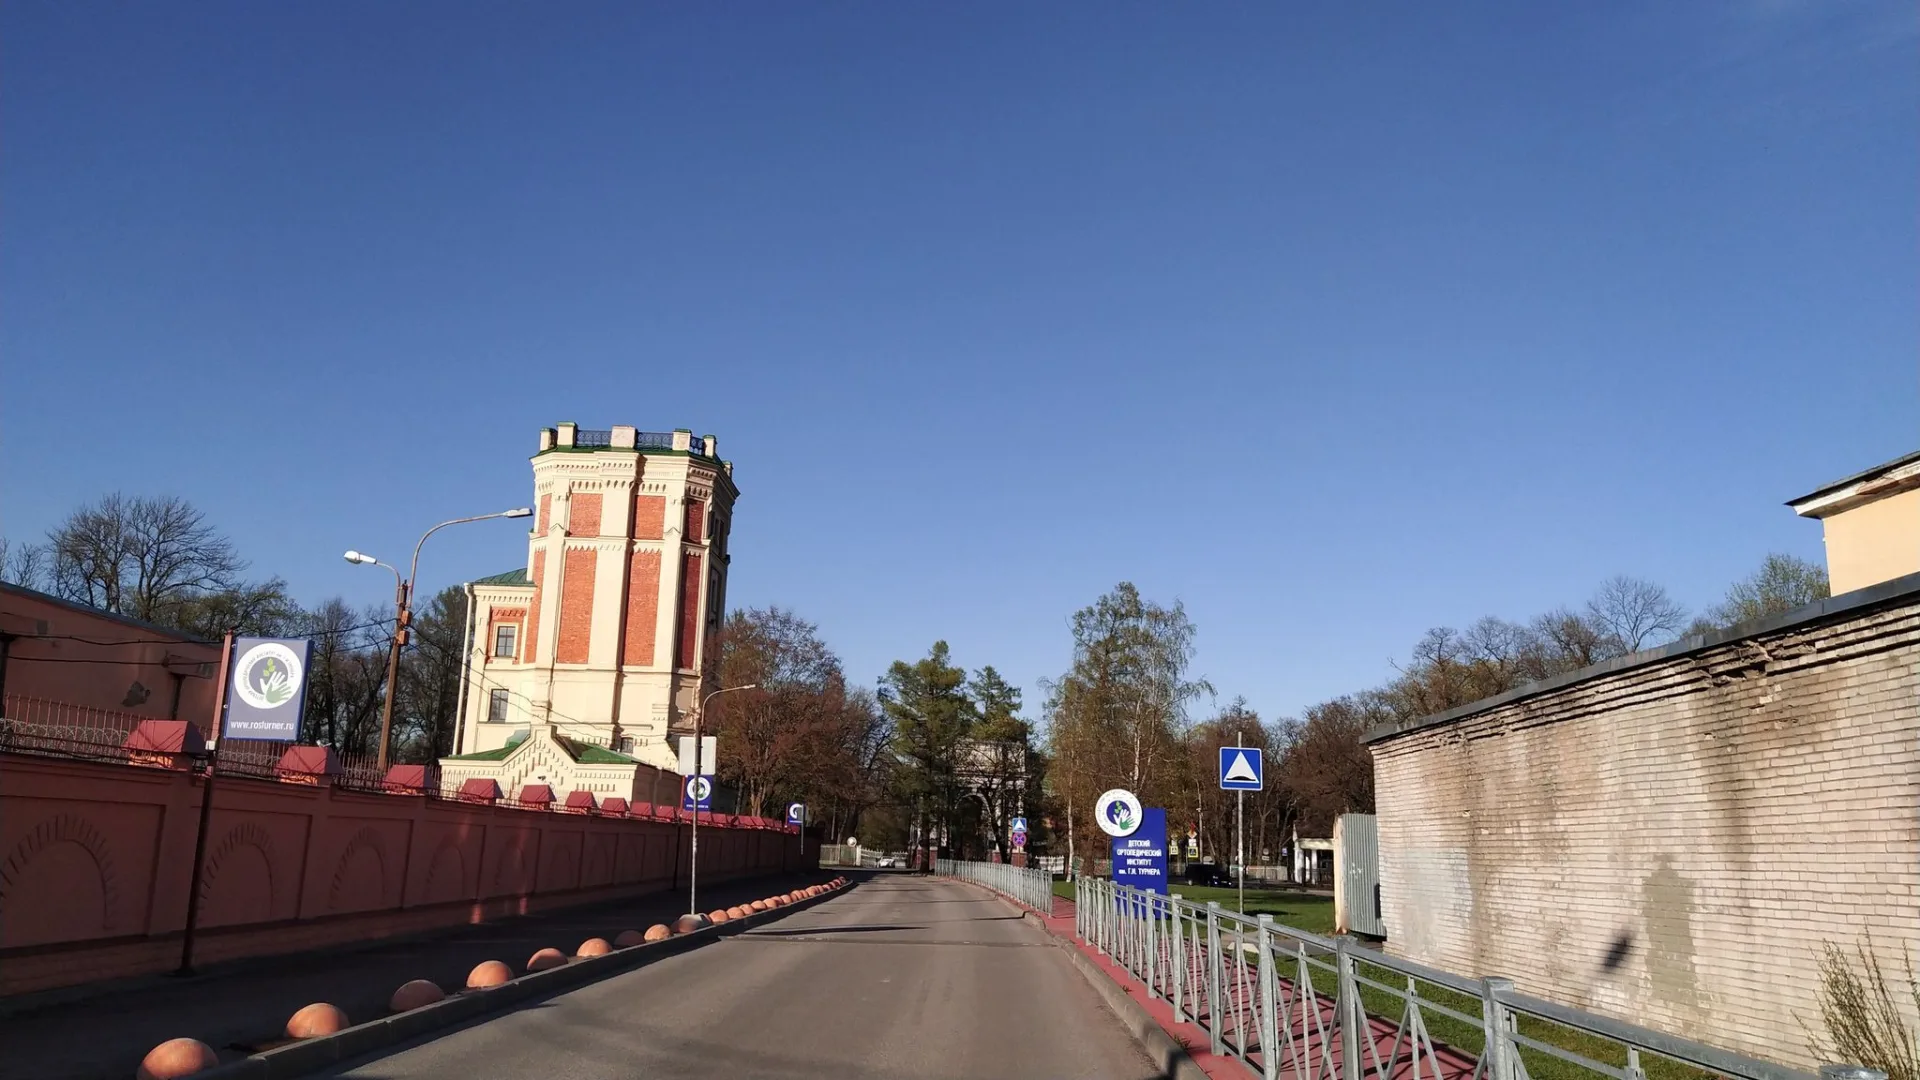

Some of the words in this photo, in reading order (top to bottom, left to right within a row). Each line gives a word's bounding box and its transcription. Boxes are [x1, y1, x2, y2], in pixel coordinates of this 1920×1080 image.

[230, 721, 294, 730] www.rosturner.ru
[1128, 839, 1150, 847] ДЕТСКИЙ
[1116, 849, 1162, 857] ОРТОПЕДИЧЕСКИЙ
[1126, 858, 1152, 866] ИНСТИТУТ
[1138, 868, 1161, 876] ТУРНЕРА
